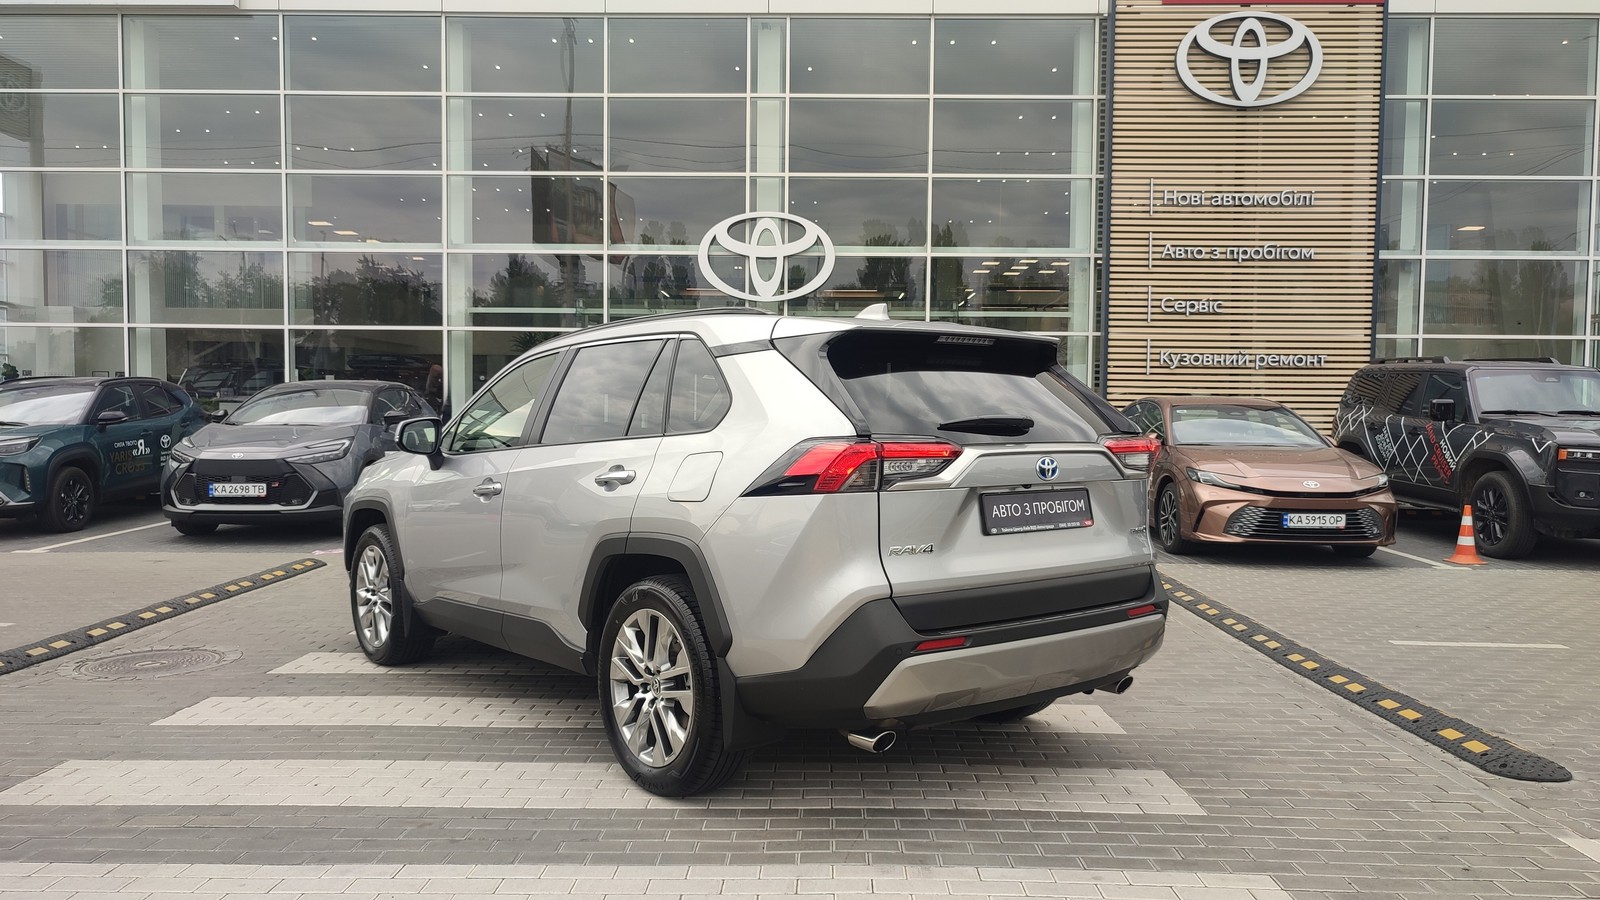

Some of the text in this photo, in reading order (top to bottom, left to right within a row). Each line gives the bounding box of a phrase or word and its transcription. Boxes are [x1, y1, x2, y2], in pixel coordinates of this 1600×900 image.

[1163, 189, 1316, 206] Нові автомобілі
[1161, 243, 1315, 264] Авто з пробігом
[1160, 296, 1224, 317] Сервіс
[1159, 350, 1328, 370] Кузовний ремонт
[110, 450, 133, 463] YARIS
[1425, 421, 1452, 478] LAND CRUISER
[1439, 438, 1457, 472] НОВИЙ
[214, 485, 227, 494] KA
[228, 485, 250, 494] 2698
[992, 503, 1022, 518] АВТО
[1032, 499, 1086, 515] ПРОБІГОМ
[1288, 515, 1303, 525] KA
[1305, 515, 1327, 525] 5915
[887, 543, 934, 557] RAV4
